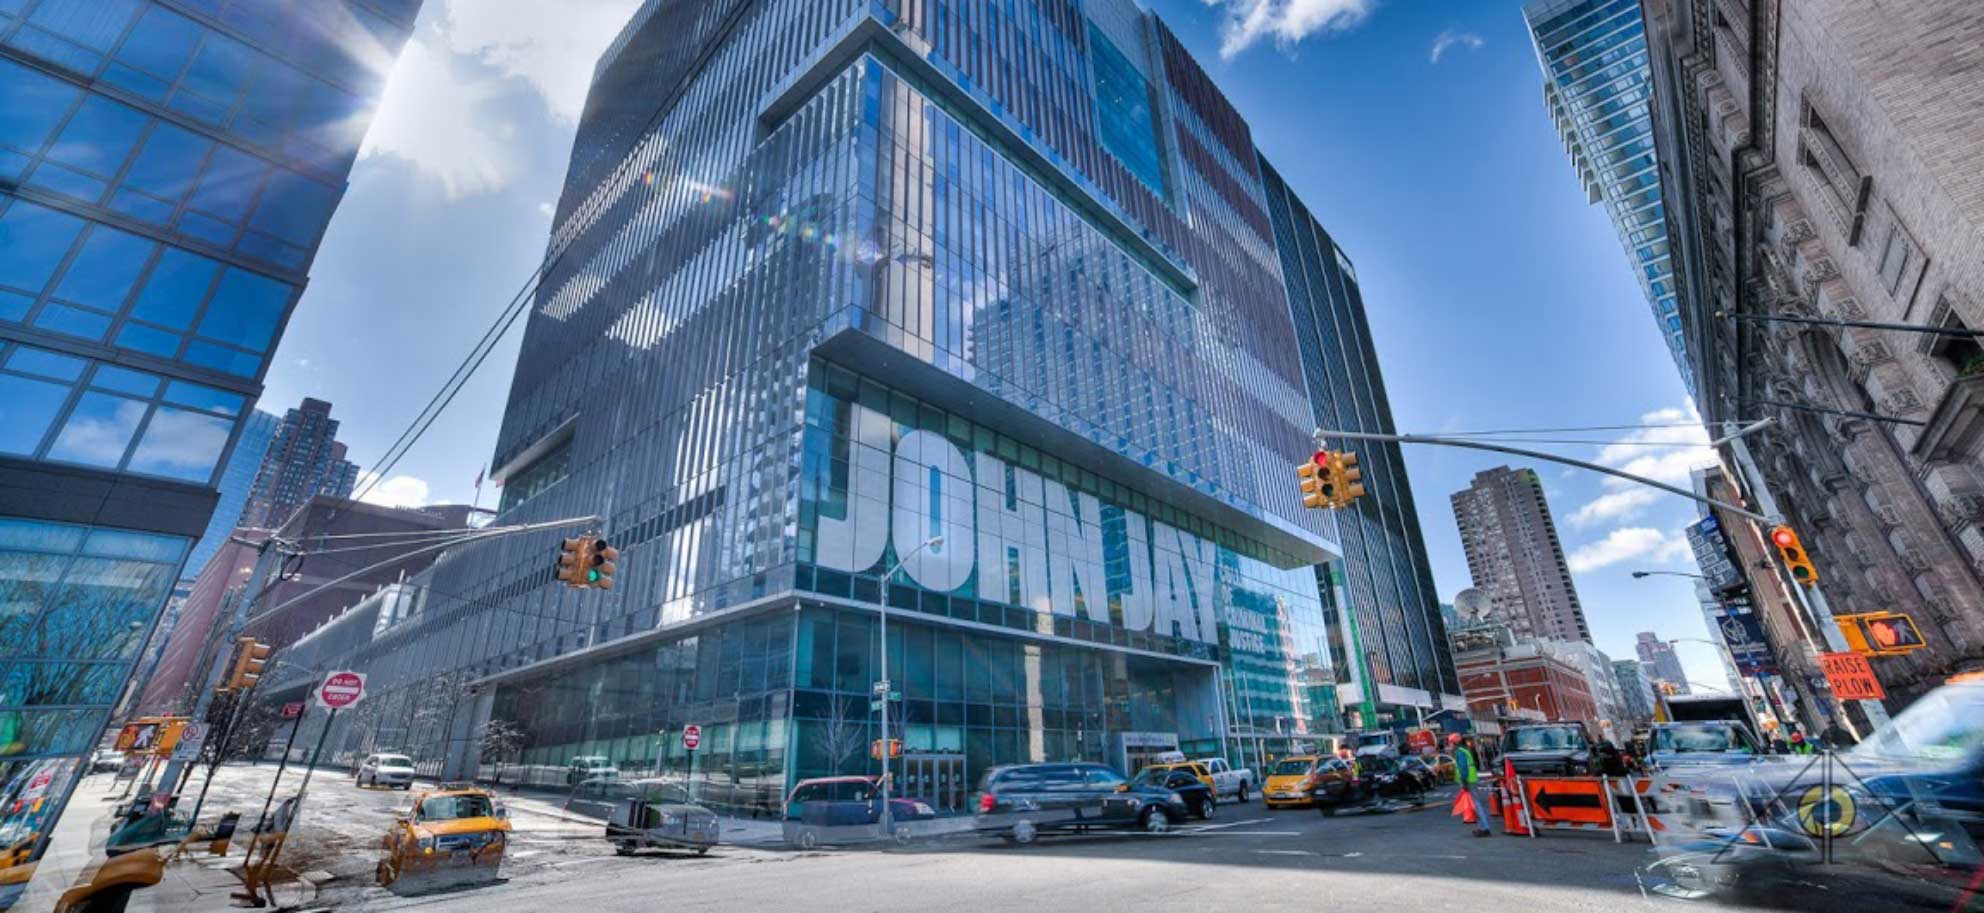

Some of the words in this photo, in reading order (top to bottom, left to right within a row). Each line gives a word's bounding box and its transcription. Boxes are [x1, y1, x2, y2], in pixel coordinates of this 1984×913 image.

[816, 402, 1110, 623] JOHN
[1122, 510, 1219, 645] JAY
[1229, 628, 1266, 654] JUSTICE
[1823, 657, 1866, 674] RAISE
[1834, 678, 1877, 695] PLOW
